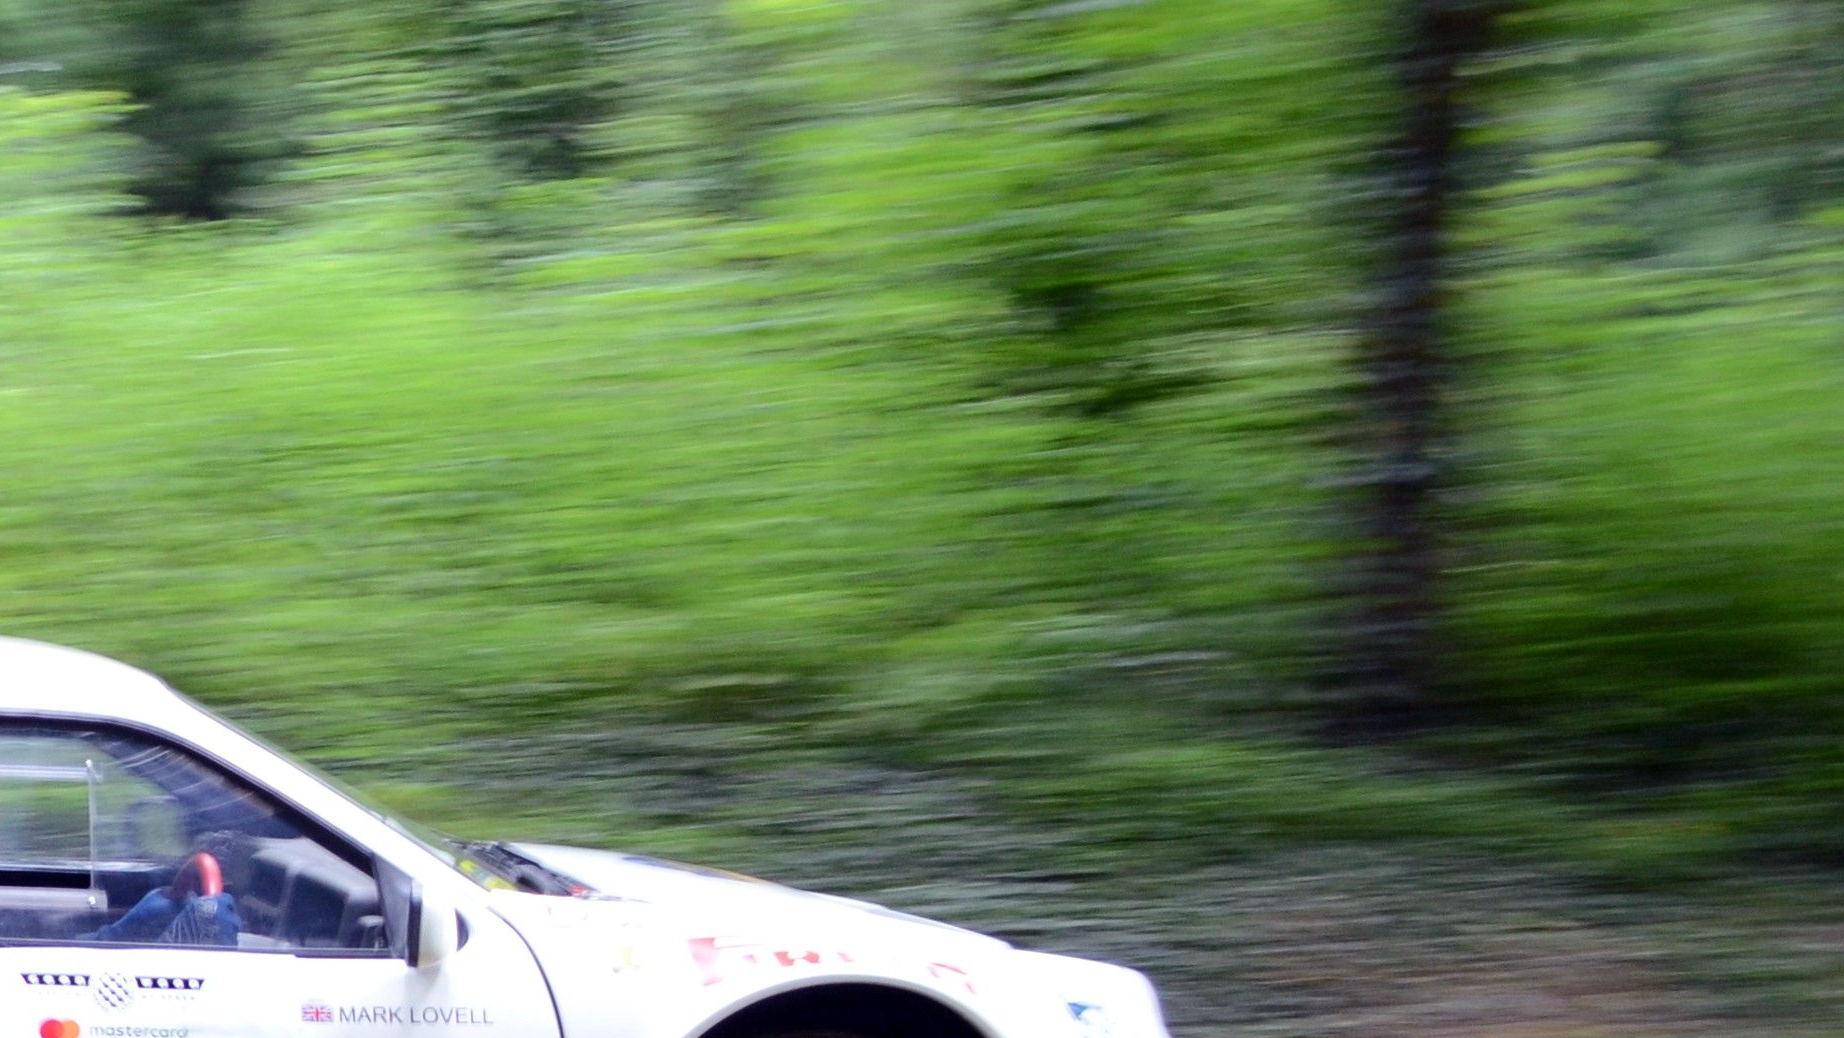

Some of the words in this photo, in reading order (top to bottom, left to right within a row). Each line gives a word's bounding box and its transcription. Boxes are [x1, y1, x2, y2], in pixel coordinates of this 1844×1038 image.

[338, 1004, 403, 1025] MARK
[410, 1006, 495, 1026] LOVELL
[89, 1023, 189, 1038] mastercard
